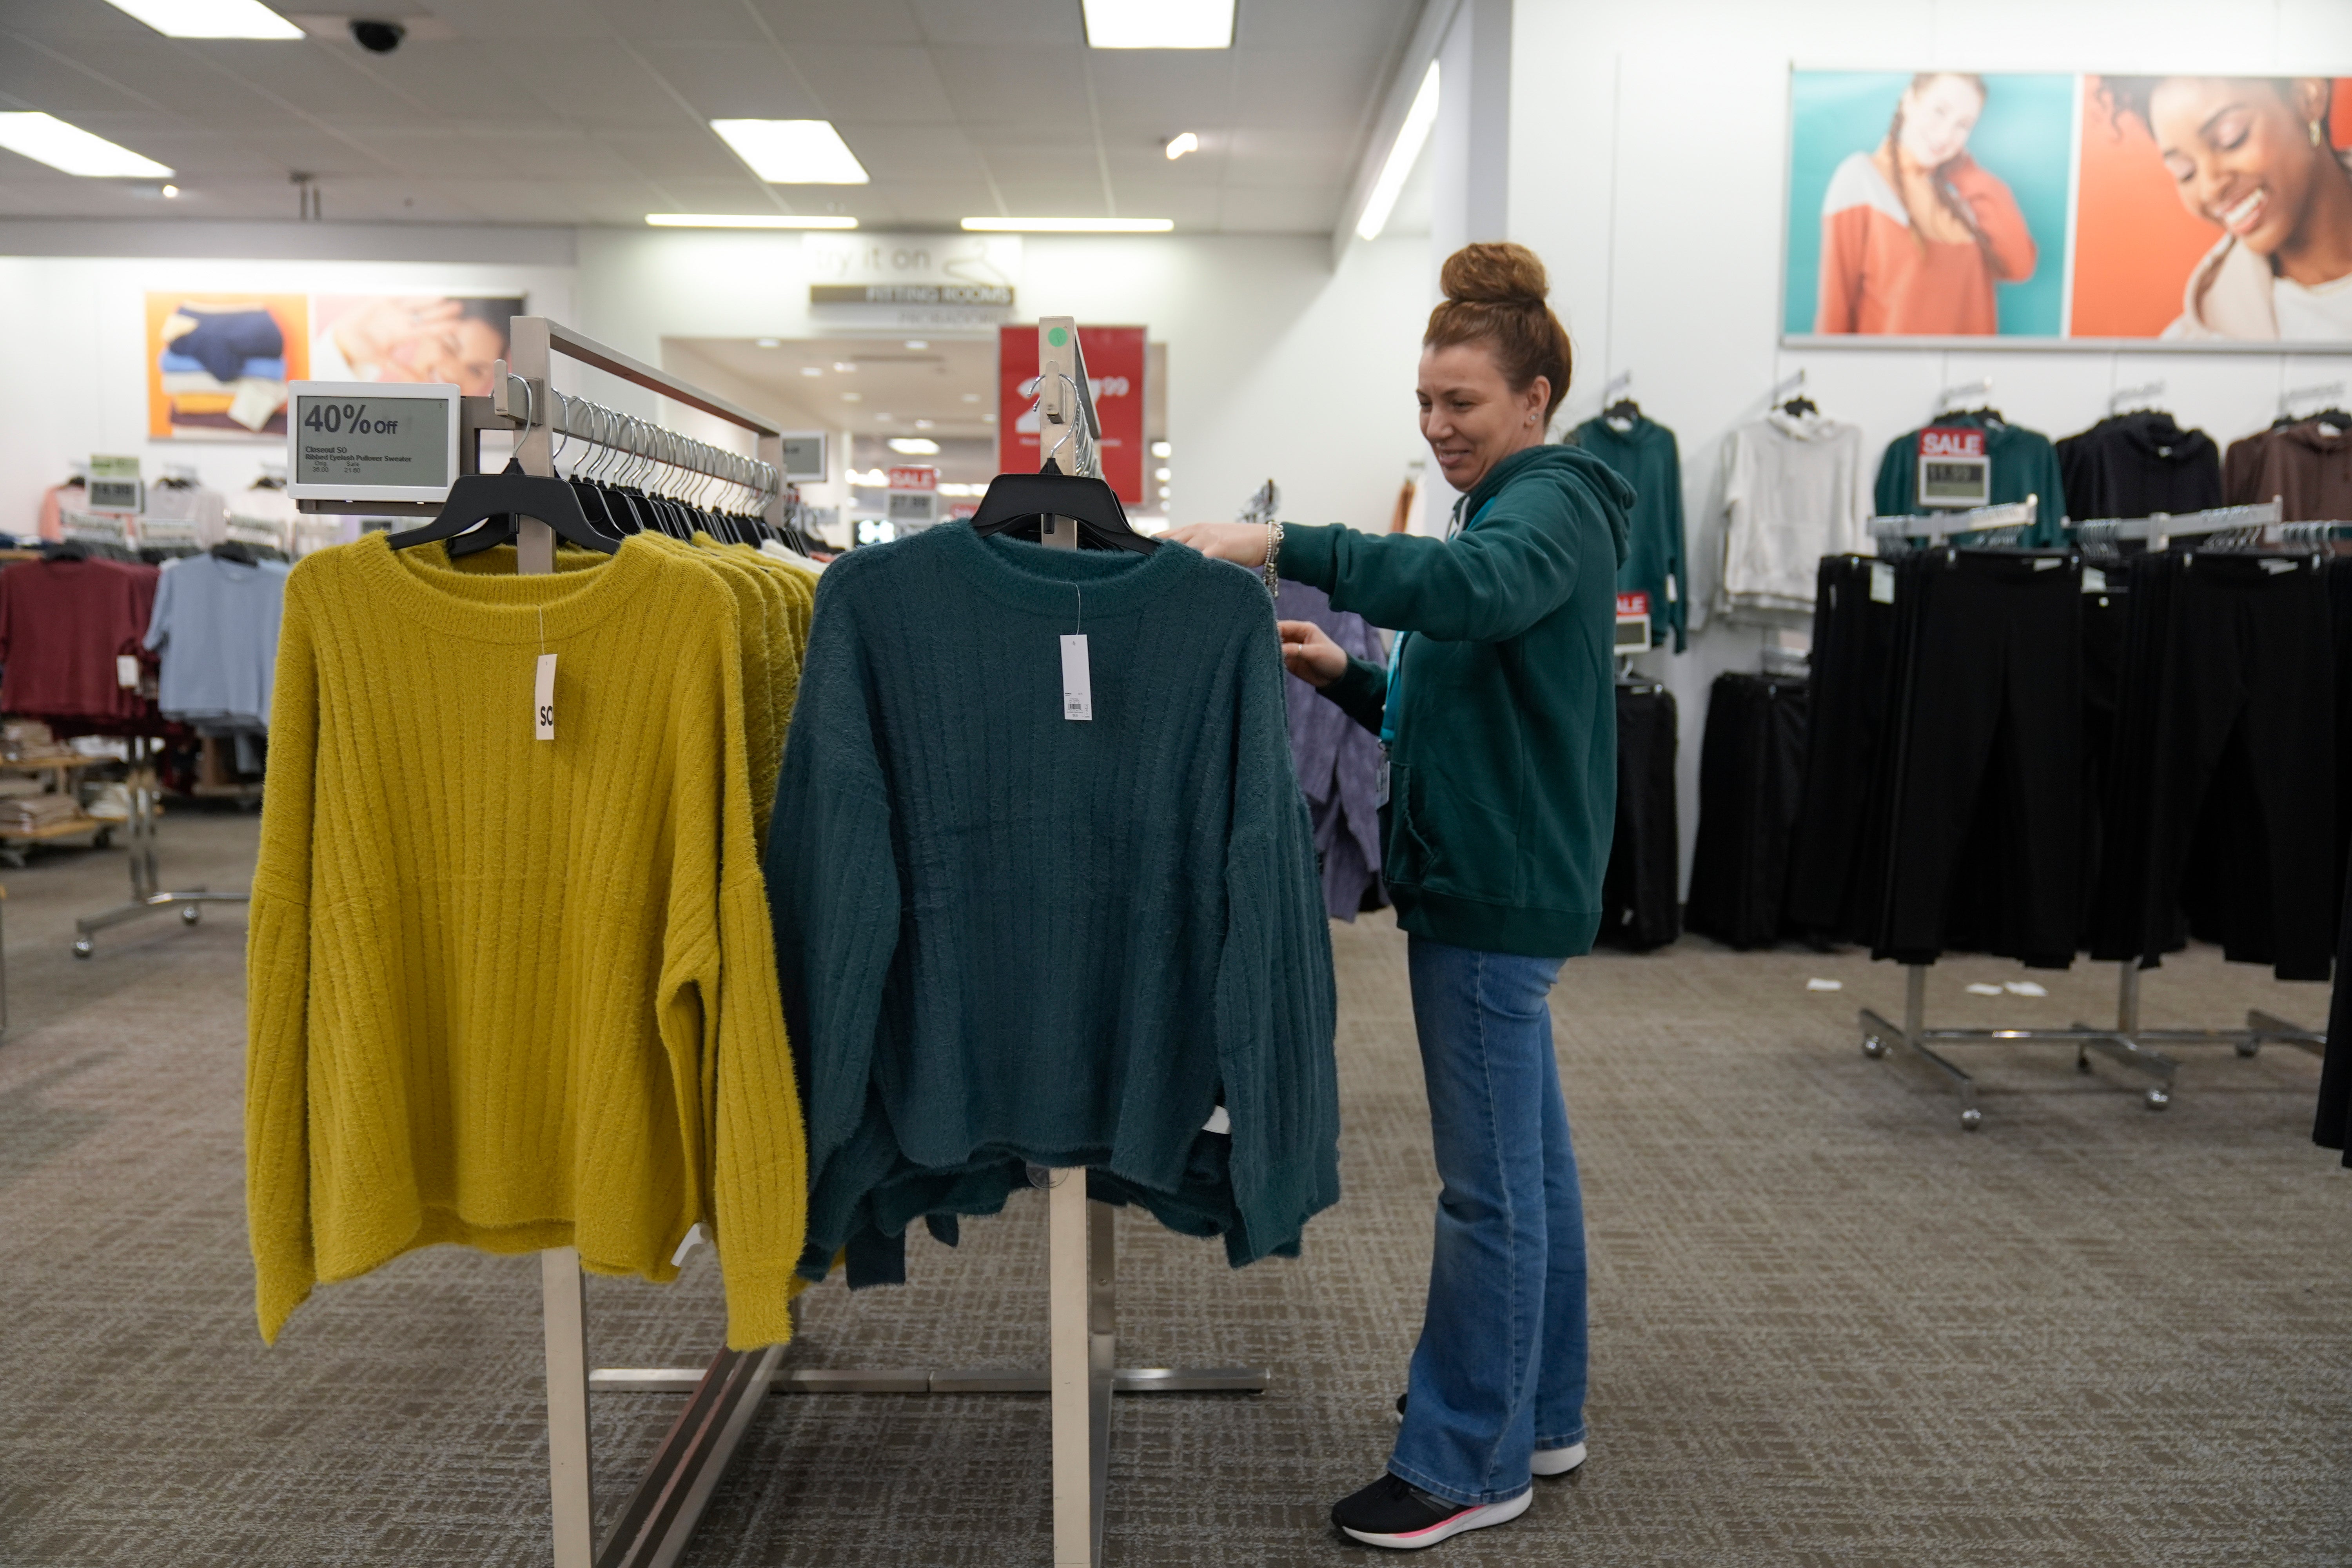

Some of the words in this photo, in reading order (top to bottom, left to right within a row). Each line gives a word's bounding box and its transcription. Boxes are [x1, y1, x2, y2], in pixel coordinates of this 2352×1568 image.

[864, 247, 881, 270] it
[891, 248, 931, 270] on
[304, 404, 371, 434] 40%
[374, 420, 398, 434] Off
[1922, 432, 1982, 455] SALE
[891, 470, 934, 488] SALE
[1617, 595, 1644, 613] ALE
